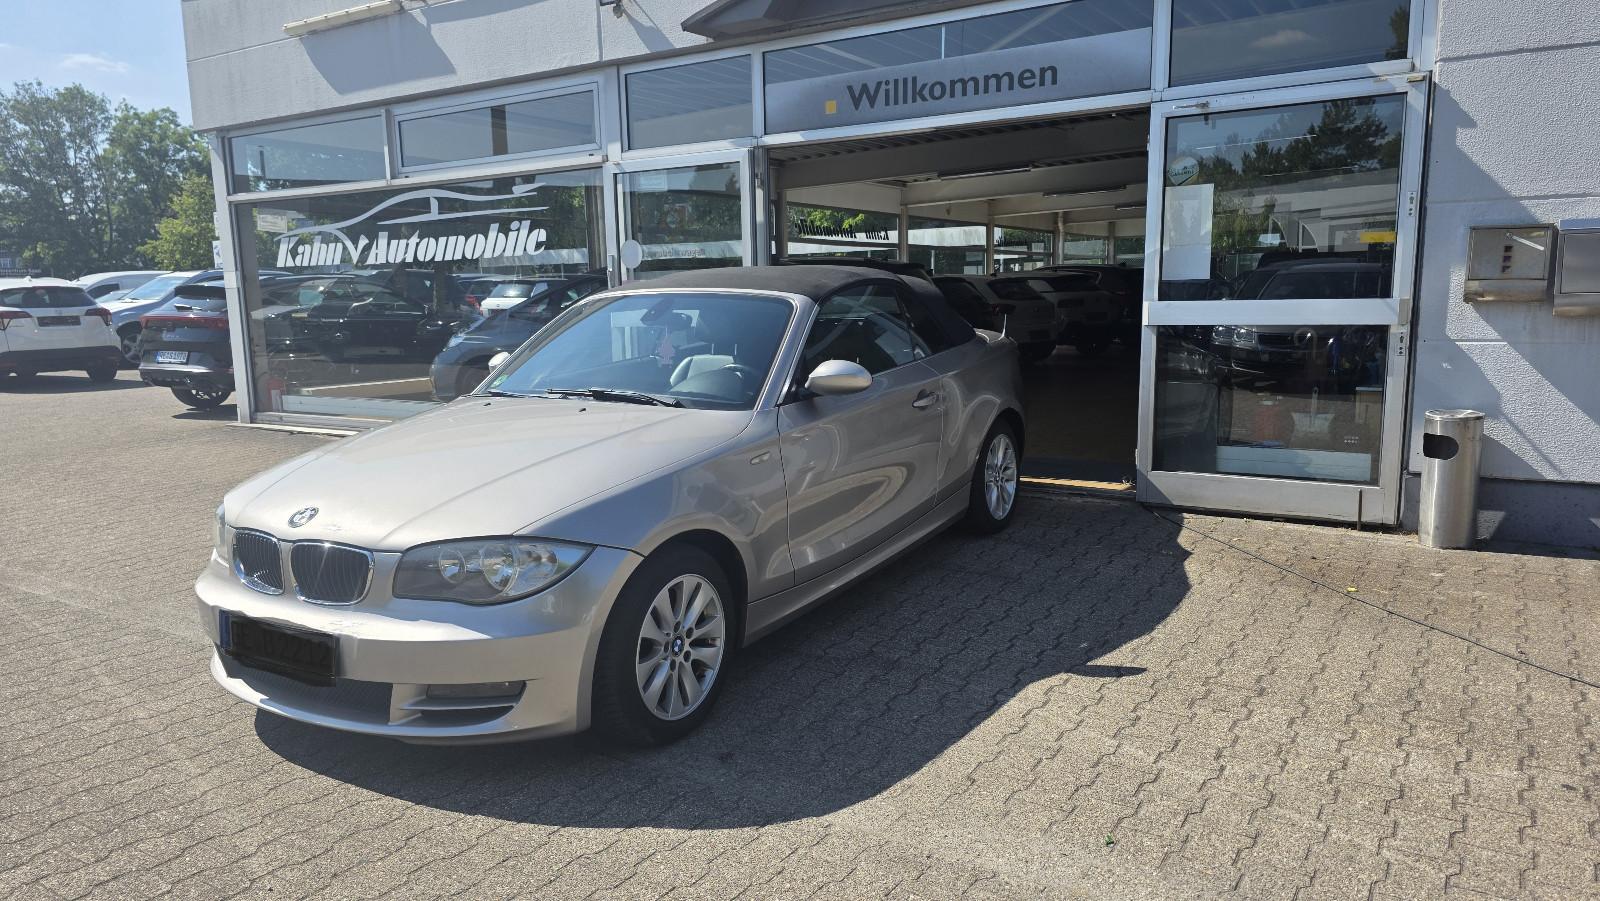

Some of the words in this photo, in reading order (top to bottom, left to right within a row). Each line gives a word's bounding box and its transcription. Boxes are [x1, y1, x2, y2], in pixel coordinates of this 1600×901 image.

[846, 64, 1058, 111] Willkommen
[276, 235, 343, 268] Kahn
[364, 219, 547, 265] Automobile
